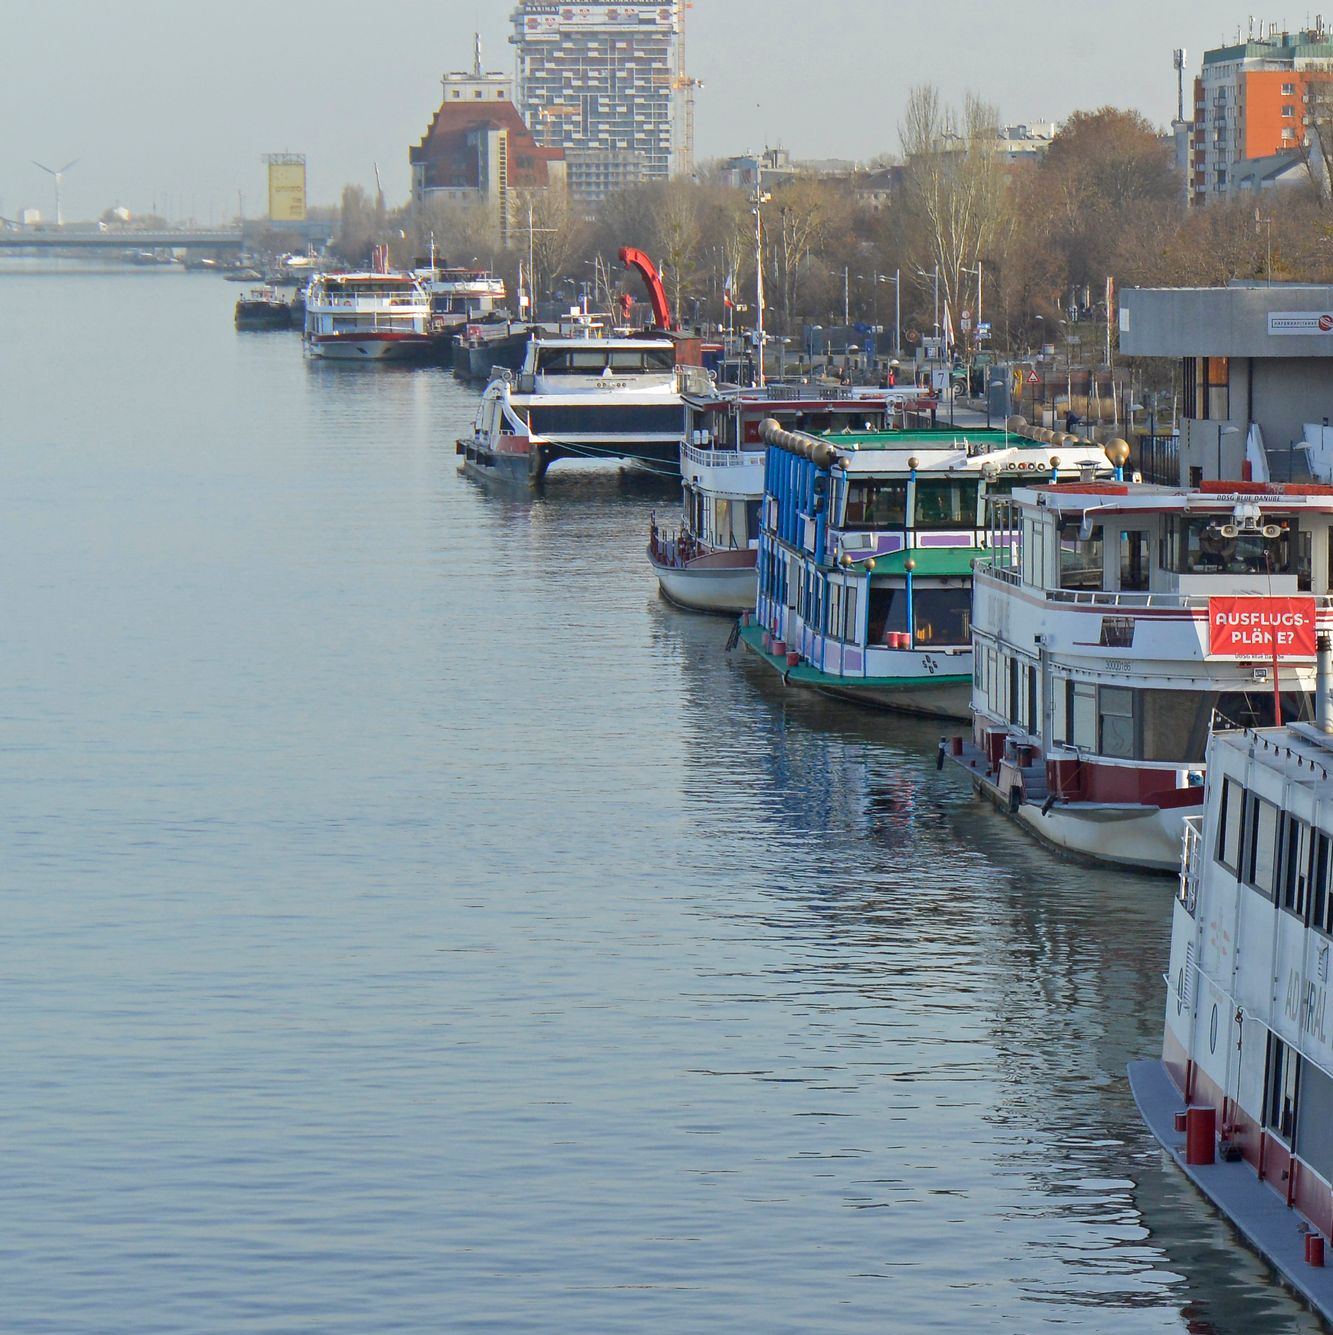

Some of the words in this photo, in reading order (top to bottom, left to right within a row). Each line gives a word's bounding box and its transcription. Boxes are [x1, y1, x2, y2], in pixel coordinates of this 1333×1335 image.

[937, 372, 945, 387] 7
[1215, 612, 1310, 626] AUSFLUGS-
[1231, 627, 1295, 645] PLÄNE?
